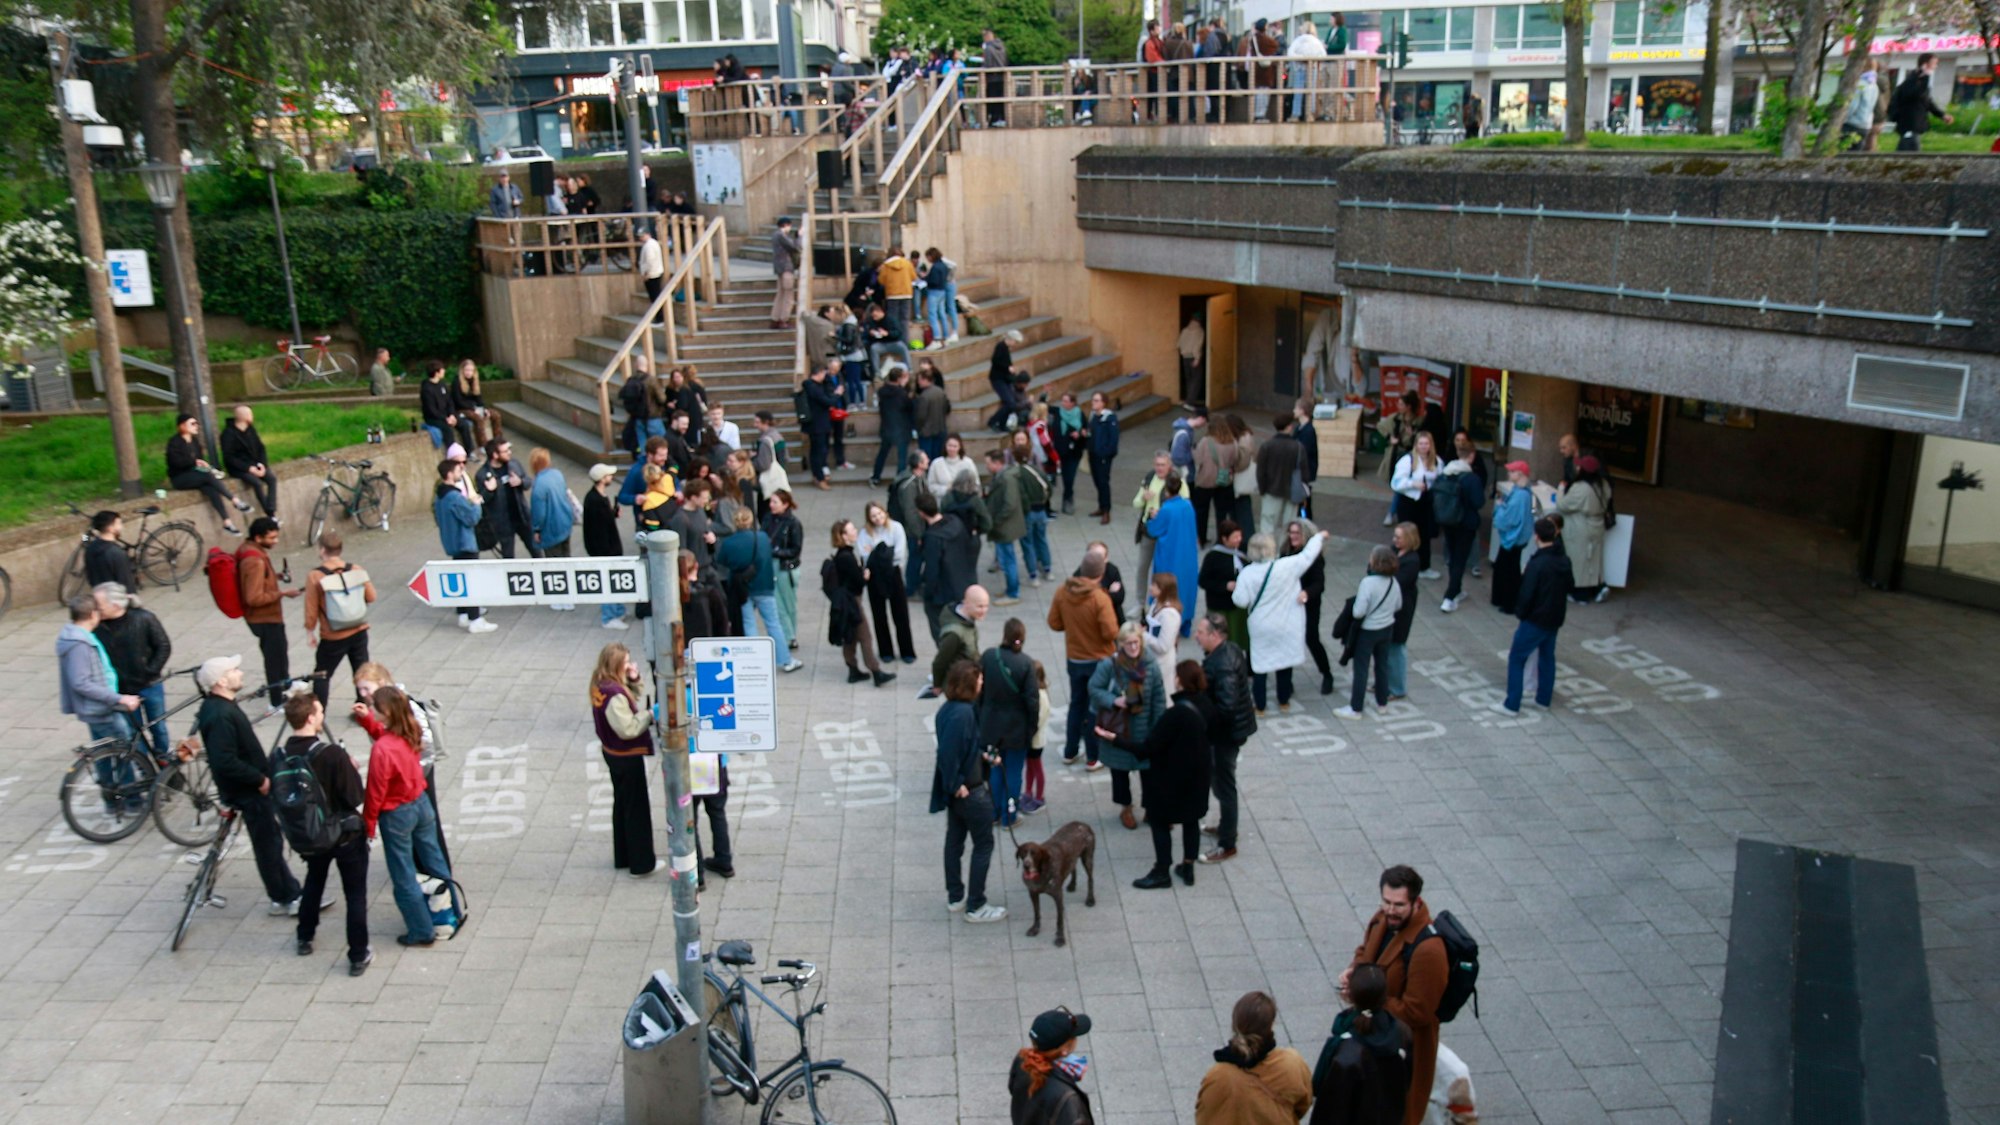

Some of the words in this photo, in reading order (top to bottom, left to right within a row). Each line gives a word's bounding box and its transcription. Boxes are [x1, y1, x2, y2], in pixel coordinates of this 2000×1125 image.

[447, 574, 464, 596] U
[509, 574, 533, 592] 12
[543, 574, 567, 591] 15
[577, 573, 600, 591] 16
[611, 572, 634, 590] 18
[441, 743, 529, 842] ÜBER
[813, 718, 902, 808] ÜBER
